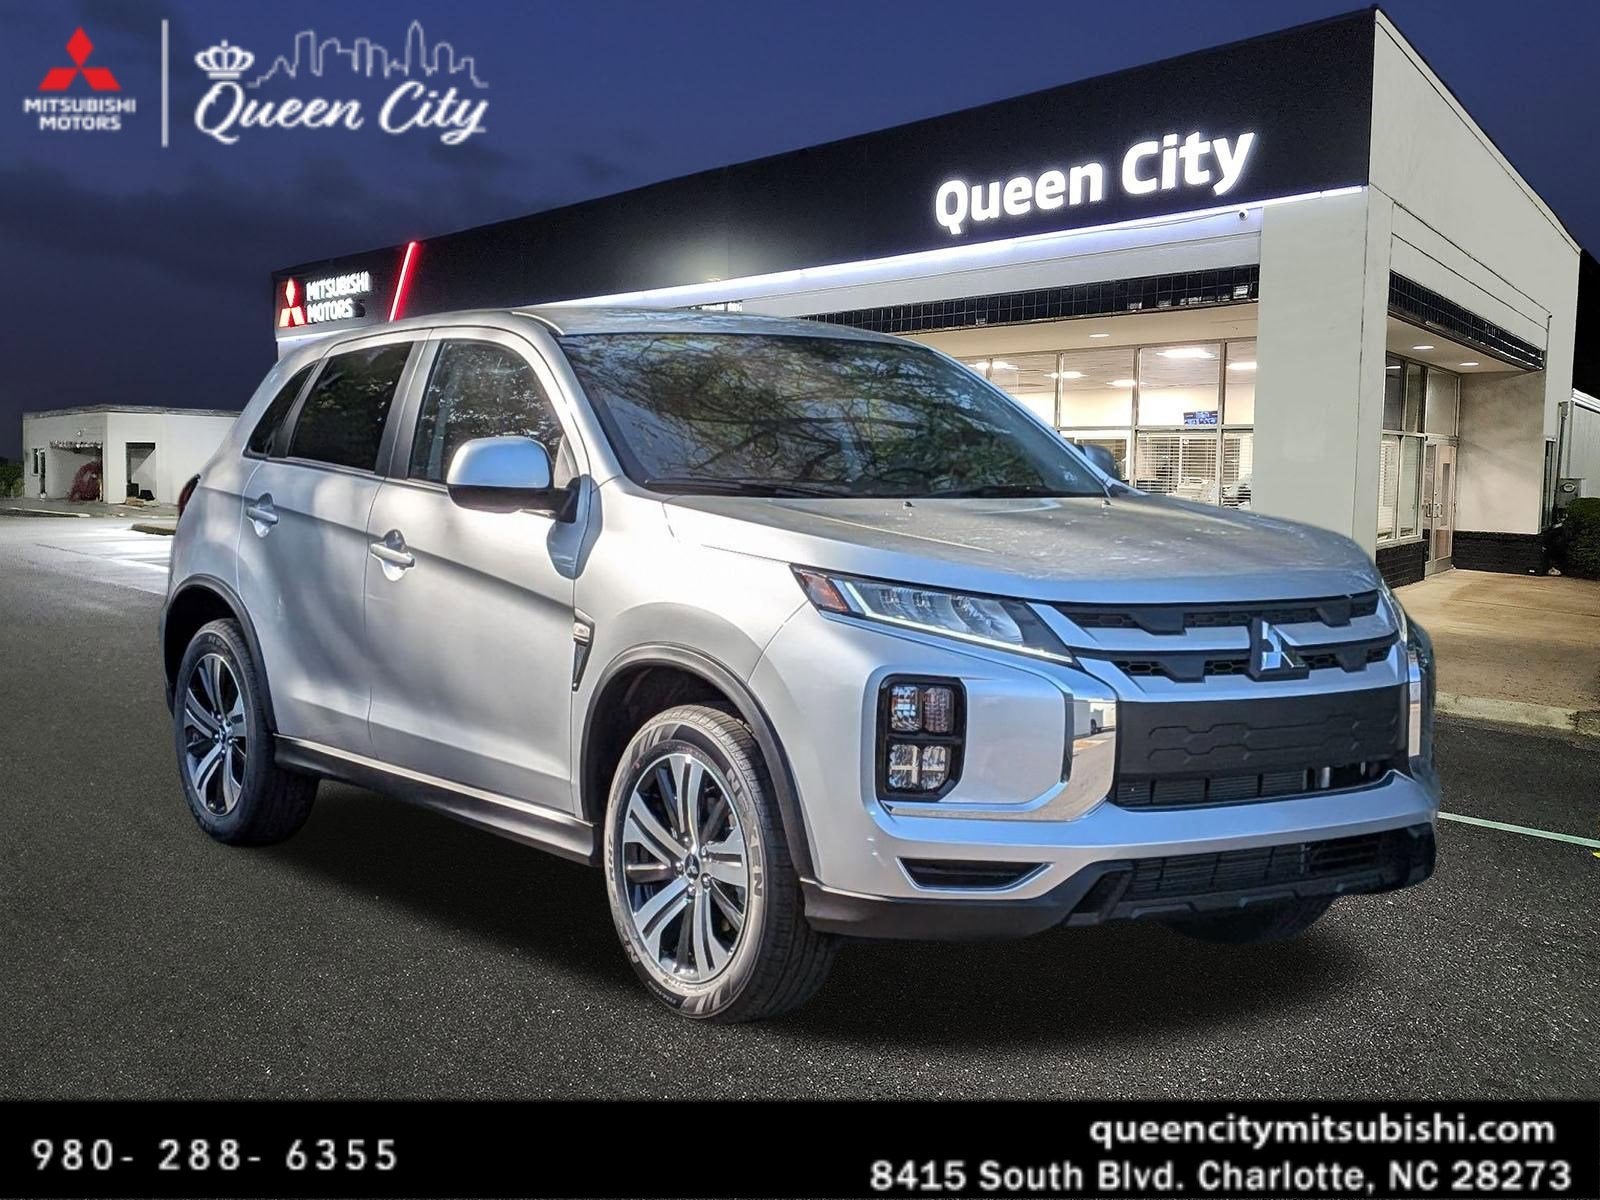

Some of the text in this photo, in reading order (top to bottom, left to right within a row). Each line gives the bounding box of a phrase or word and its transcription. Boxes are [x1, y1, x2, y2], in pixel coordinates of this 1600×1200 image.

[935, 131, 1255, 235] Queen City
[306, 271, 370, 302] MITSUBISHI
[307, 299, 354, 323] MOTORS
